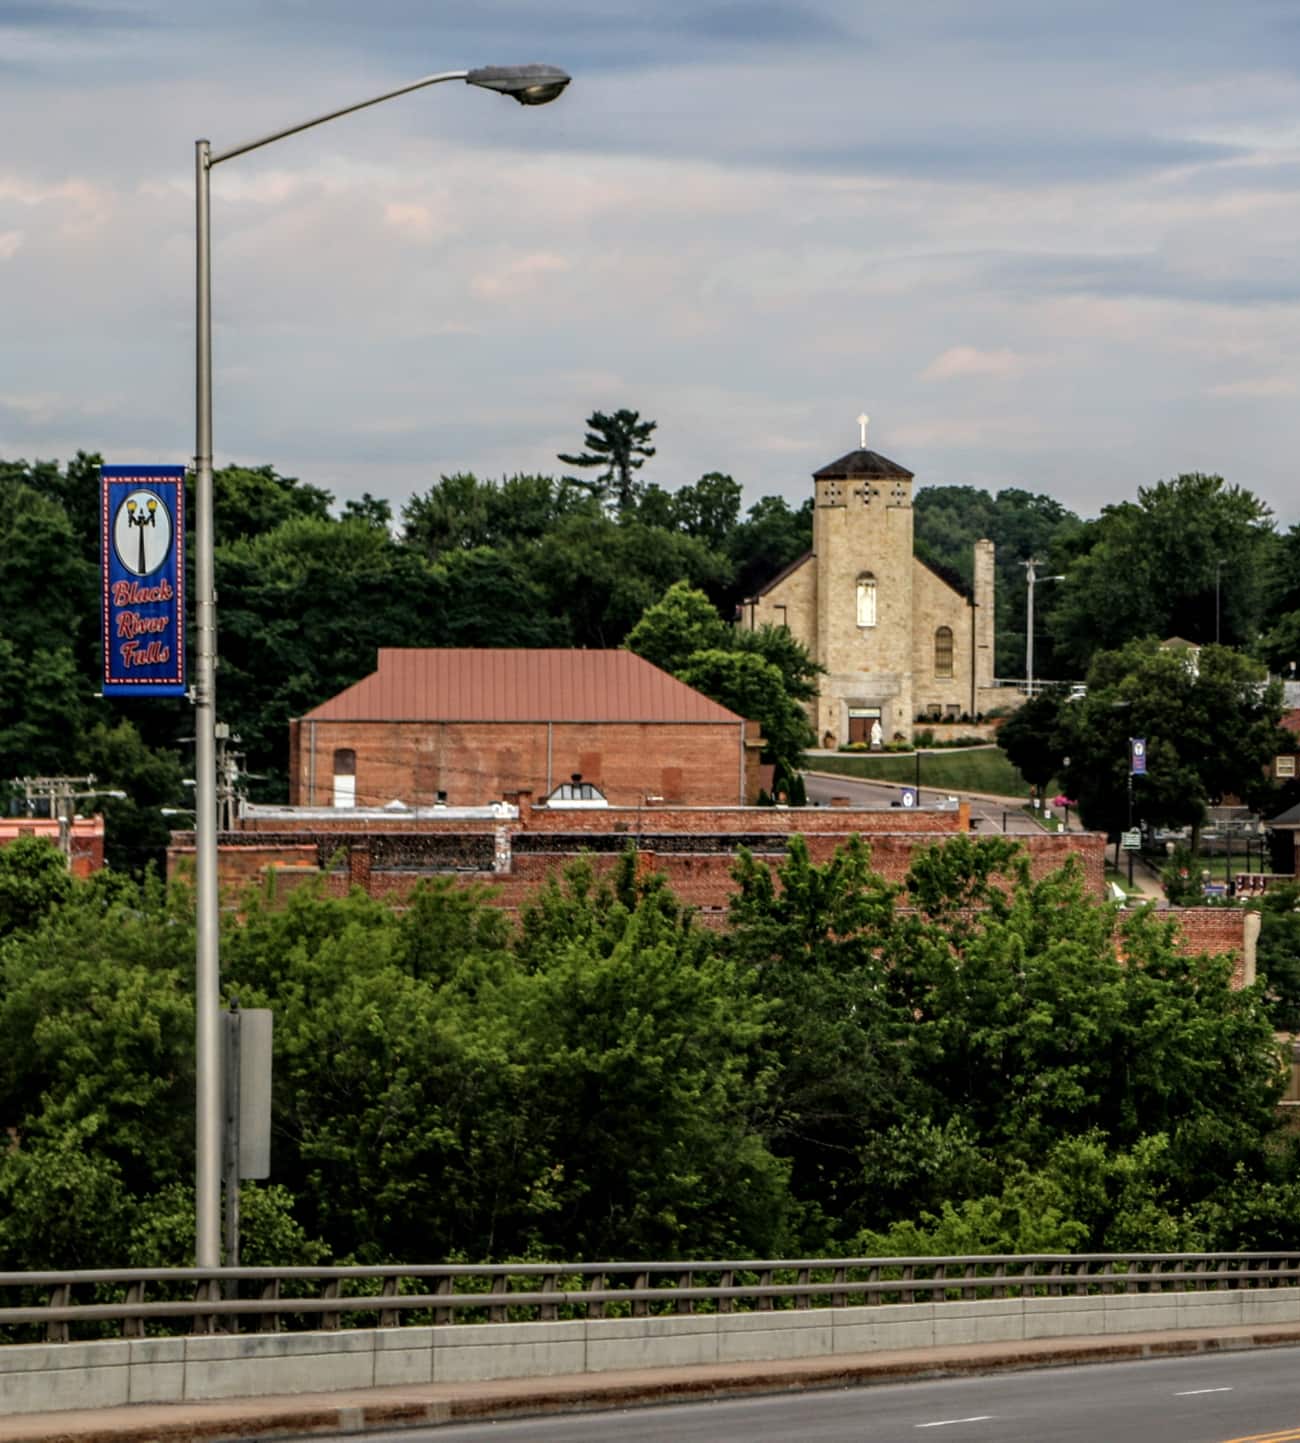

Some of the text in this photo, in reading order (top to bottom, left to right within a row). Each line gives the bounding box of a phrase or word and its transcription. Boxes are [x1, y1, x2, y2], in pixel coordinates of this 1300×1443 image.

[111, 578, 173, 607] Black
[116, 611, 169, 639] River
[120, 640, 170, 668] Falls
